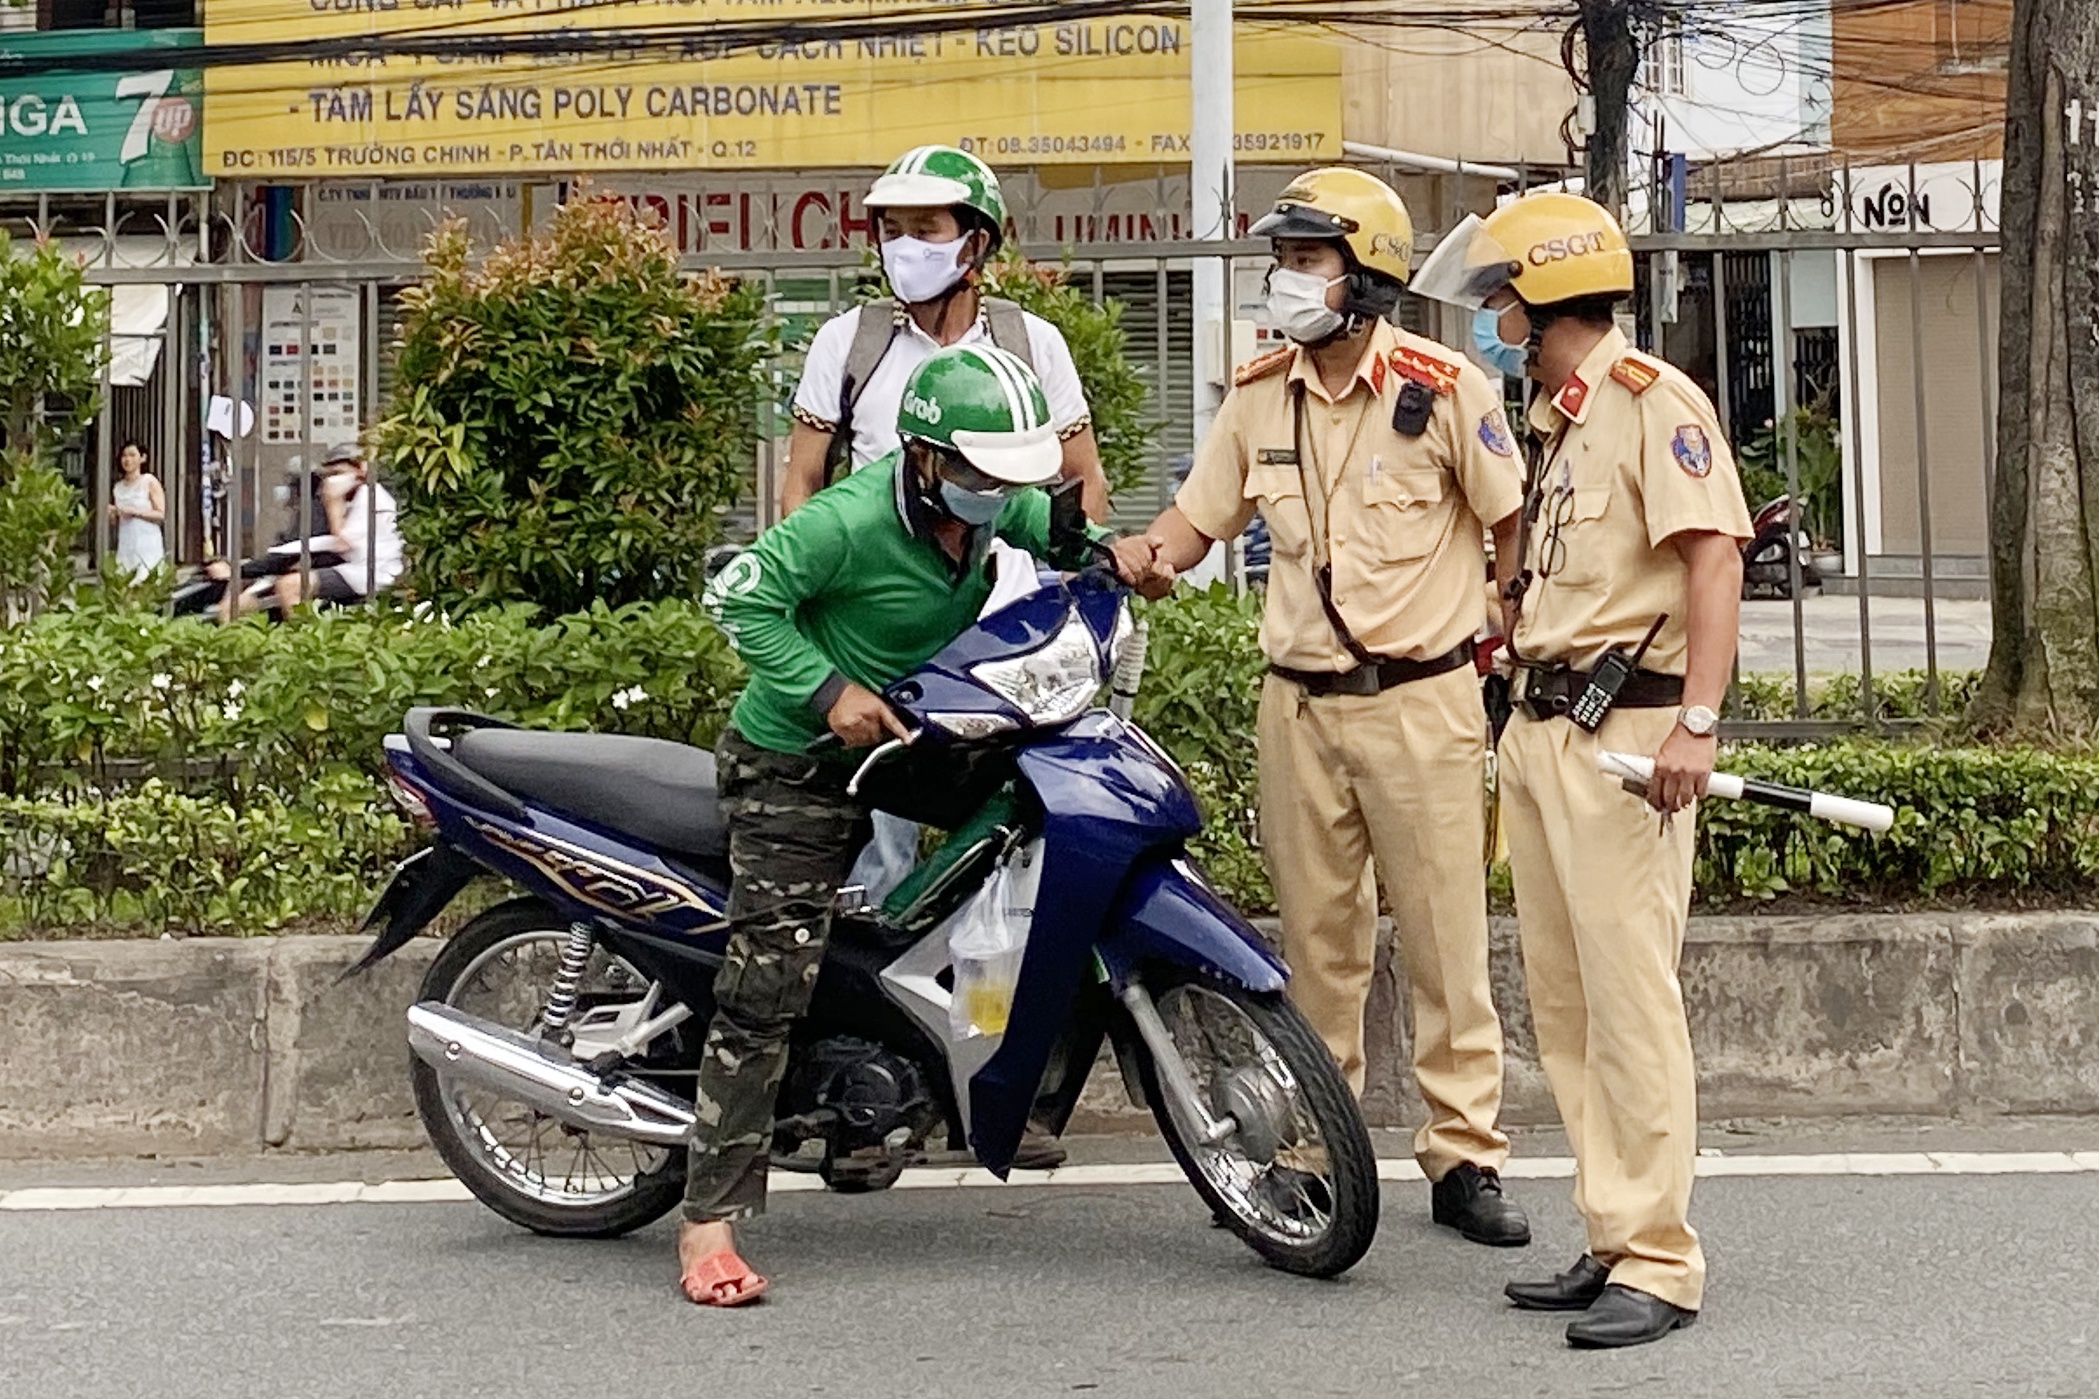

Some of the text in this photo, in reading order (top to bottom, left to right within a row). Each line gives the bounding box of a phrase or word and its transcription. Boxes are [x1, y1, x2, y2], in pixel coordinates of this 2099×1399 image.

[1055, 25, 1181, 57] SILICON
[0, 95, 88, 136] GA
[456, 83, 541, 120] SÁNG
[555, 87, 632, 119] POLY
[646, 85, 841, 117] CARBONATE
[423, 144, 489, 164] CHINH
[1527, 231, 1606, 267] CSGT
[903, 388, 942, 425] Grab
